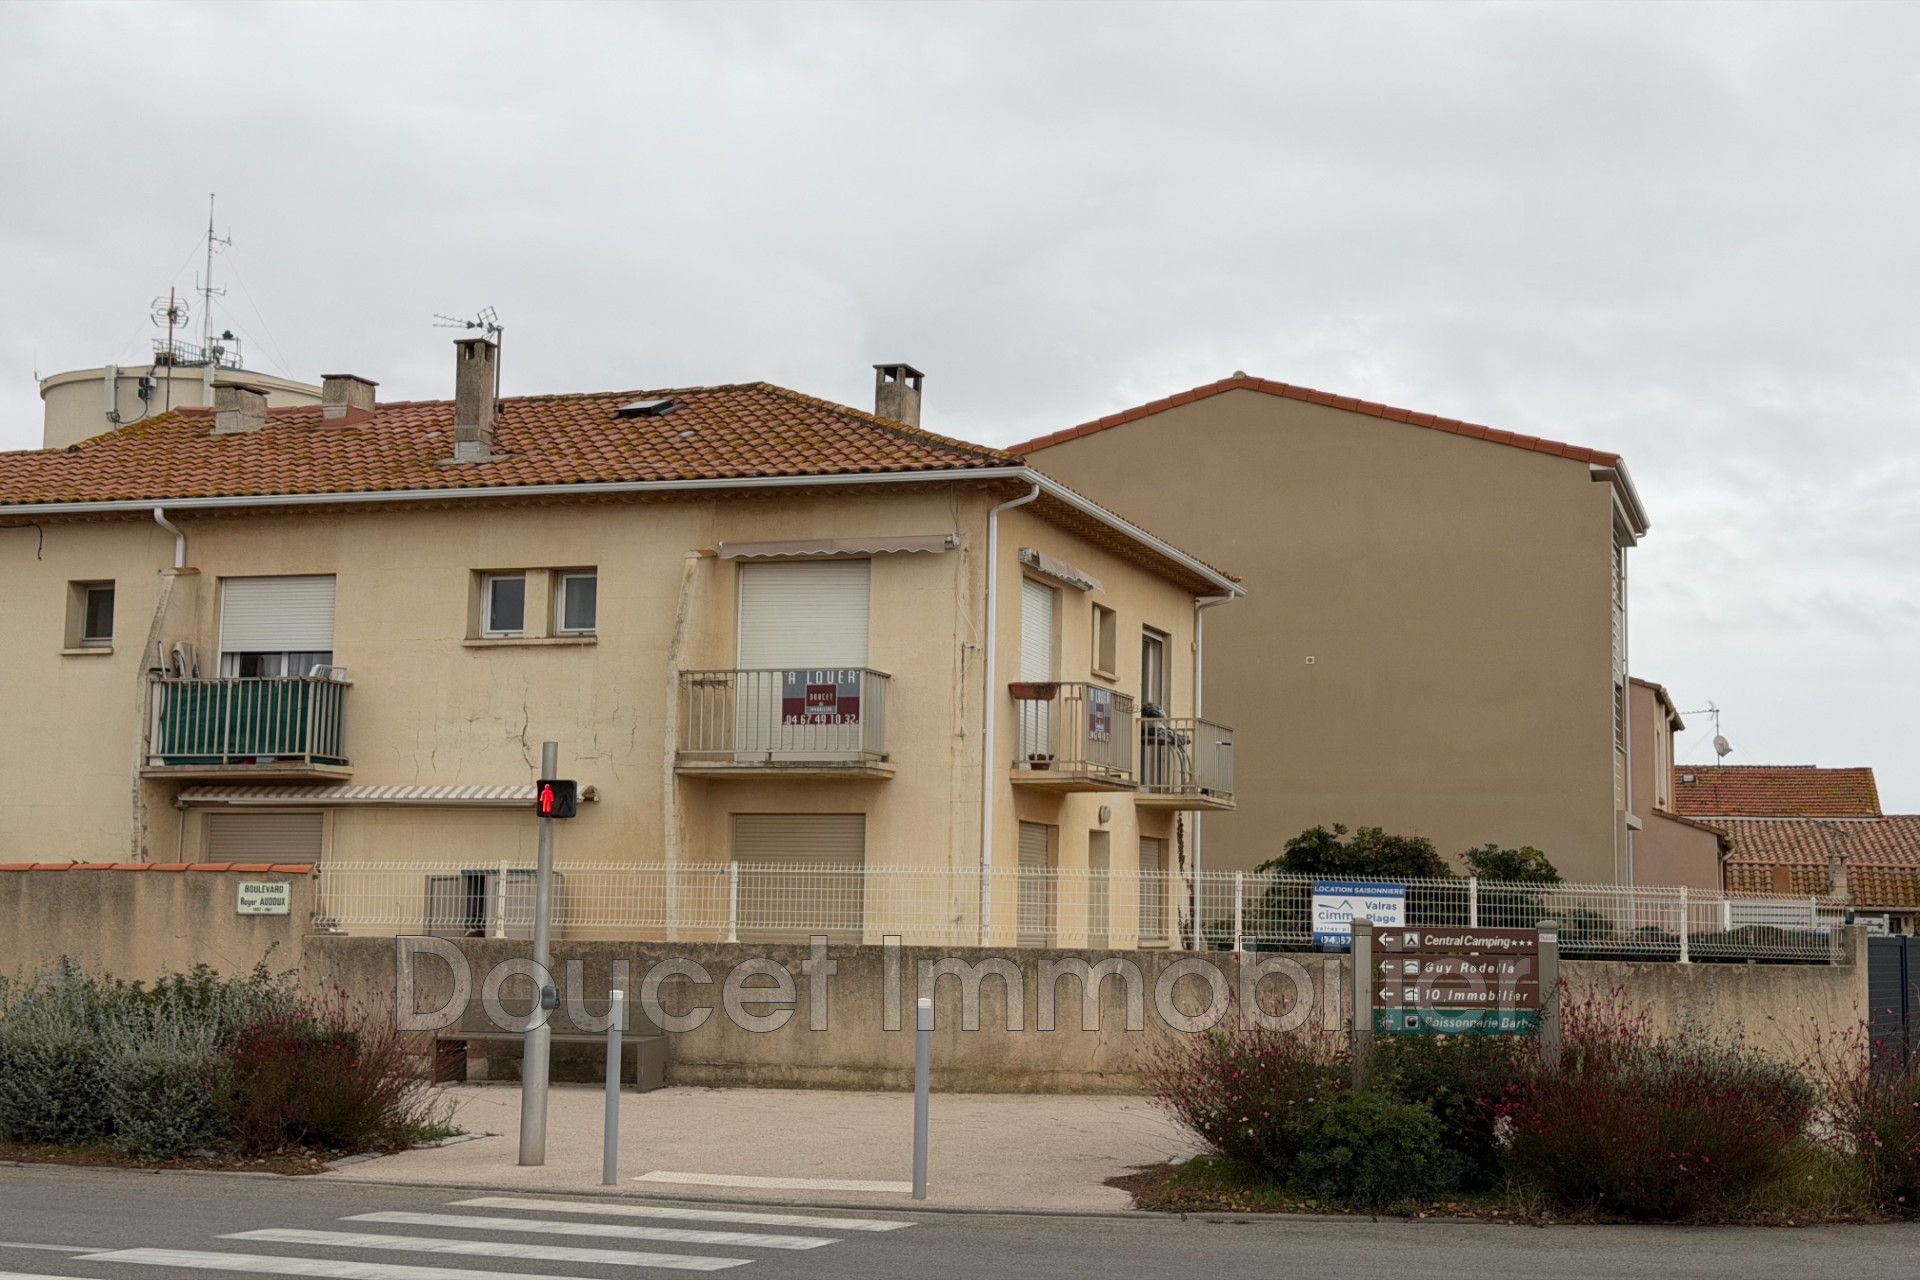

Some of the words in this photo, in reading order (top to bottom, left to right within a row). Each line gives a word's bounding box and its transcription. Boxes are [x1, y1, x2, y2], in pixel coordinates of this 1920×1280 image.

[788, 671, 796, 684] A
[806, 670, 855, 685] LOUER
[809, 693, 833, 701] DOUCET
[786, 714, 798, 725] 04
[800, 714, 812, 725] 67
[815, 714, 827, 724] 49
[830, 714, 841, 724] 10
[244, 884, 284, 893] BOULEVARD
[1314, 885, 1353, 893] LOCATION
[1354, 887, 1403, 895] SAISONNIERE
[240, 897, 257, 908] Roger
[1365, 901, 1397, 911] Valras
[1318, 909, 1353, 920] cimm
[1366, 913, 1396, 923] Plage
[1424, 934, 1464, 946] Central
[1464, 934, 1511, 949] Camping
[1424, 961, 1452, 974] Guy
[1460, 962, 1515, 974] Rodella
